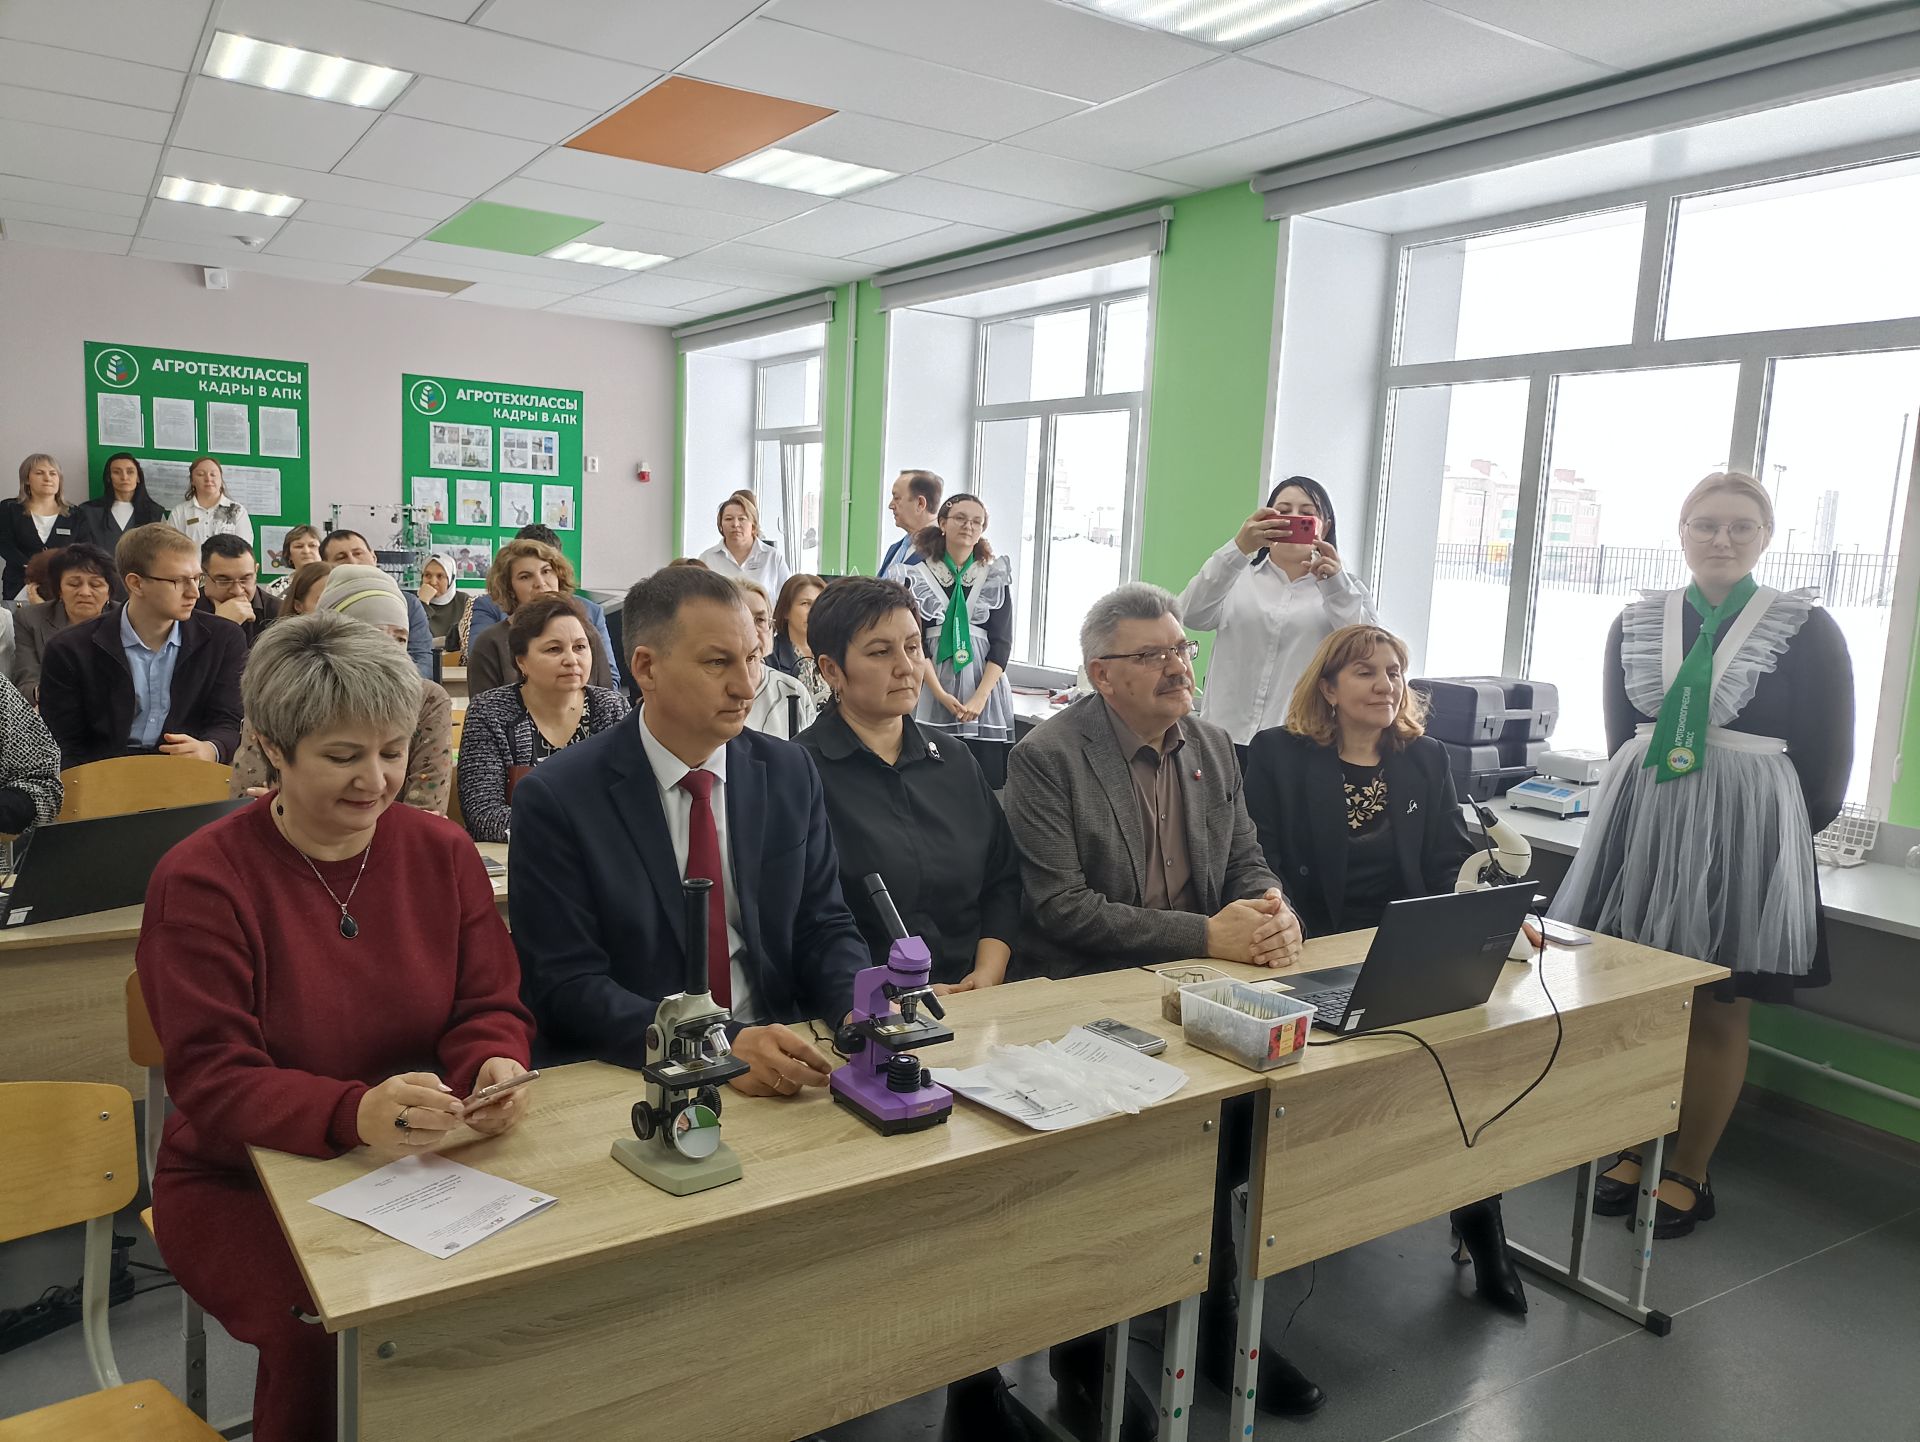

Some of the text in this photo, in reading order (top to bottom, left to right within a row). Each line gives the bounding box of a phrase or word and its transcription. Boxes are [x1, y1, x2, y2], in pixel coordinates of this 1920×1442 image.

[152, 358, 302, 384] АГРОТЕХКЛАССЫ
[199, 380, 302, 400] КАДРЫ В АПК
[456, 388, 578, 411] АГРОТЕХКЛАССЫ
[493, 408, 577, 425] КАДРЫ В АПК
